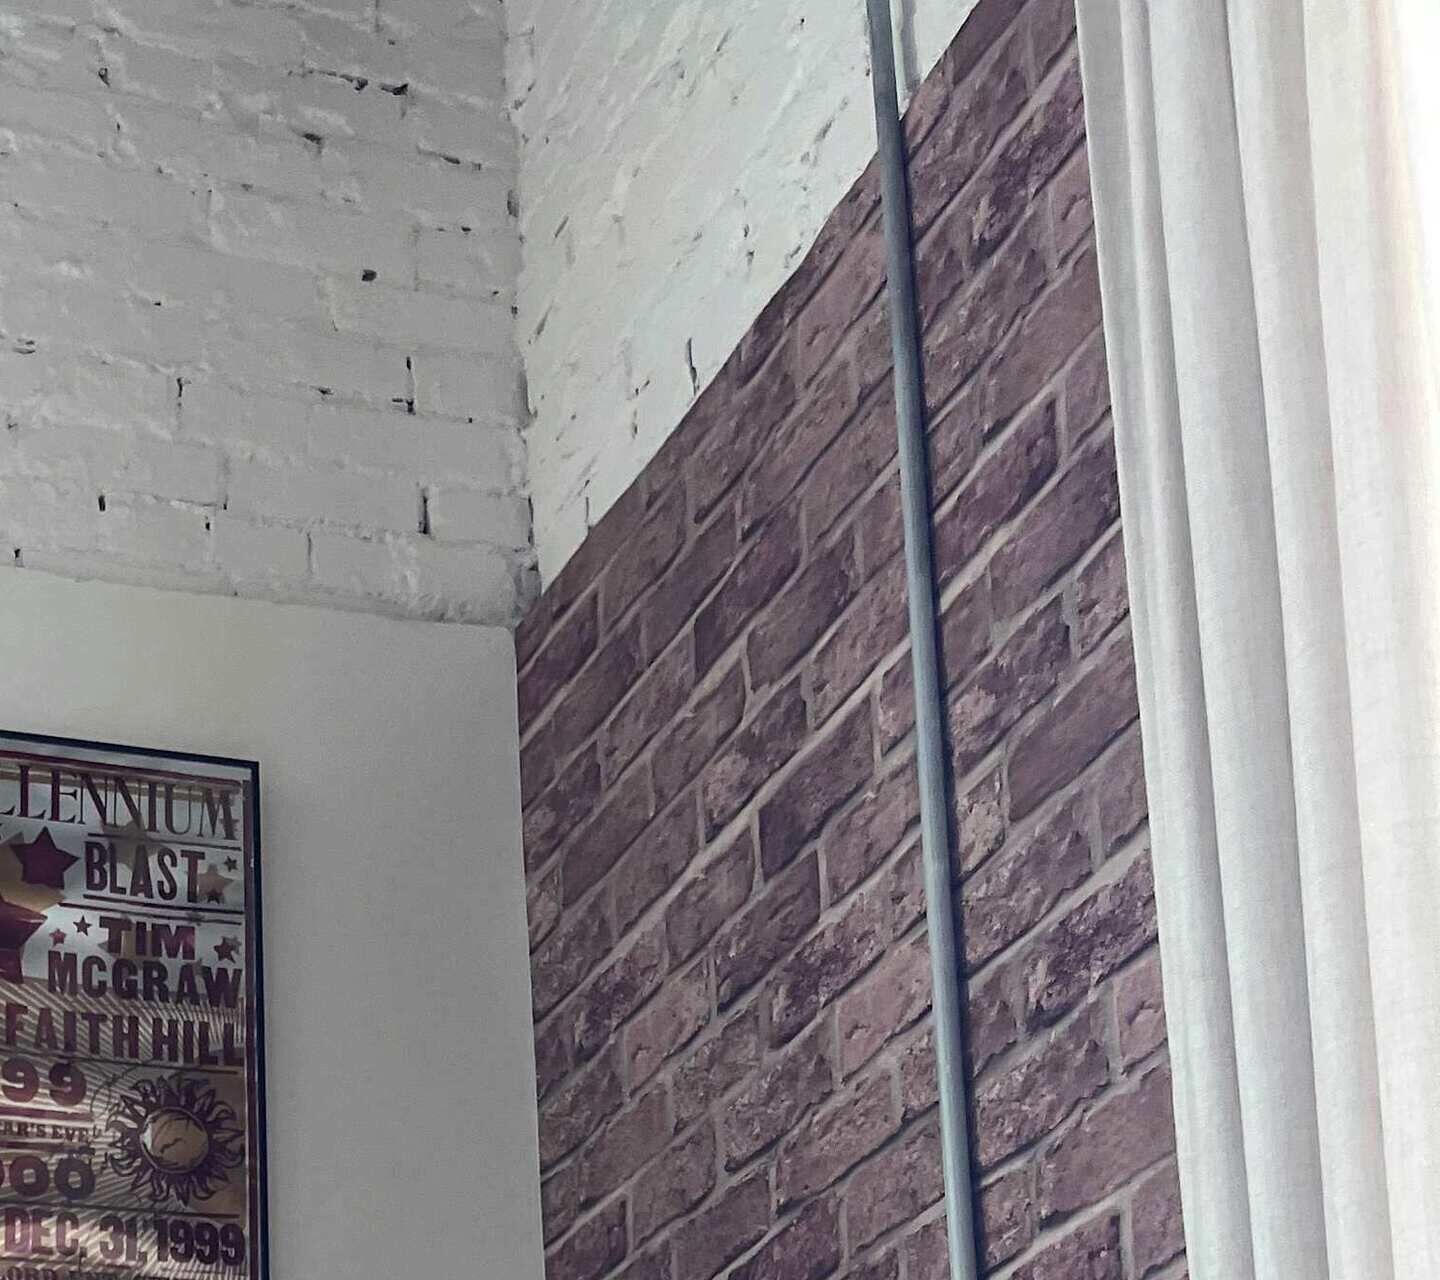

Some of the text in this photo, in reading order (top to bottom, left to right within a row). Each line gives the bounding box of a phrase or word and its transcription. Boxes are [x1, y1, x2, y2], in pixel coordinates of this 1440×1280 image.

[83, 840, 206, 904] BLAST
[99, 915, 195, 960] TIM
[6, 1002, 244, 1066] FAITH HILL
[51, 1125, 89, 1143] EVE
[157, 1214, 247, 1266] 1999
